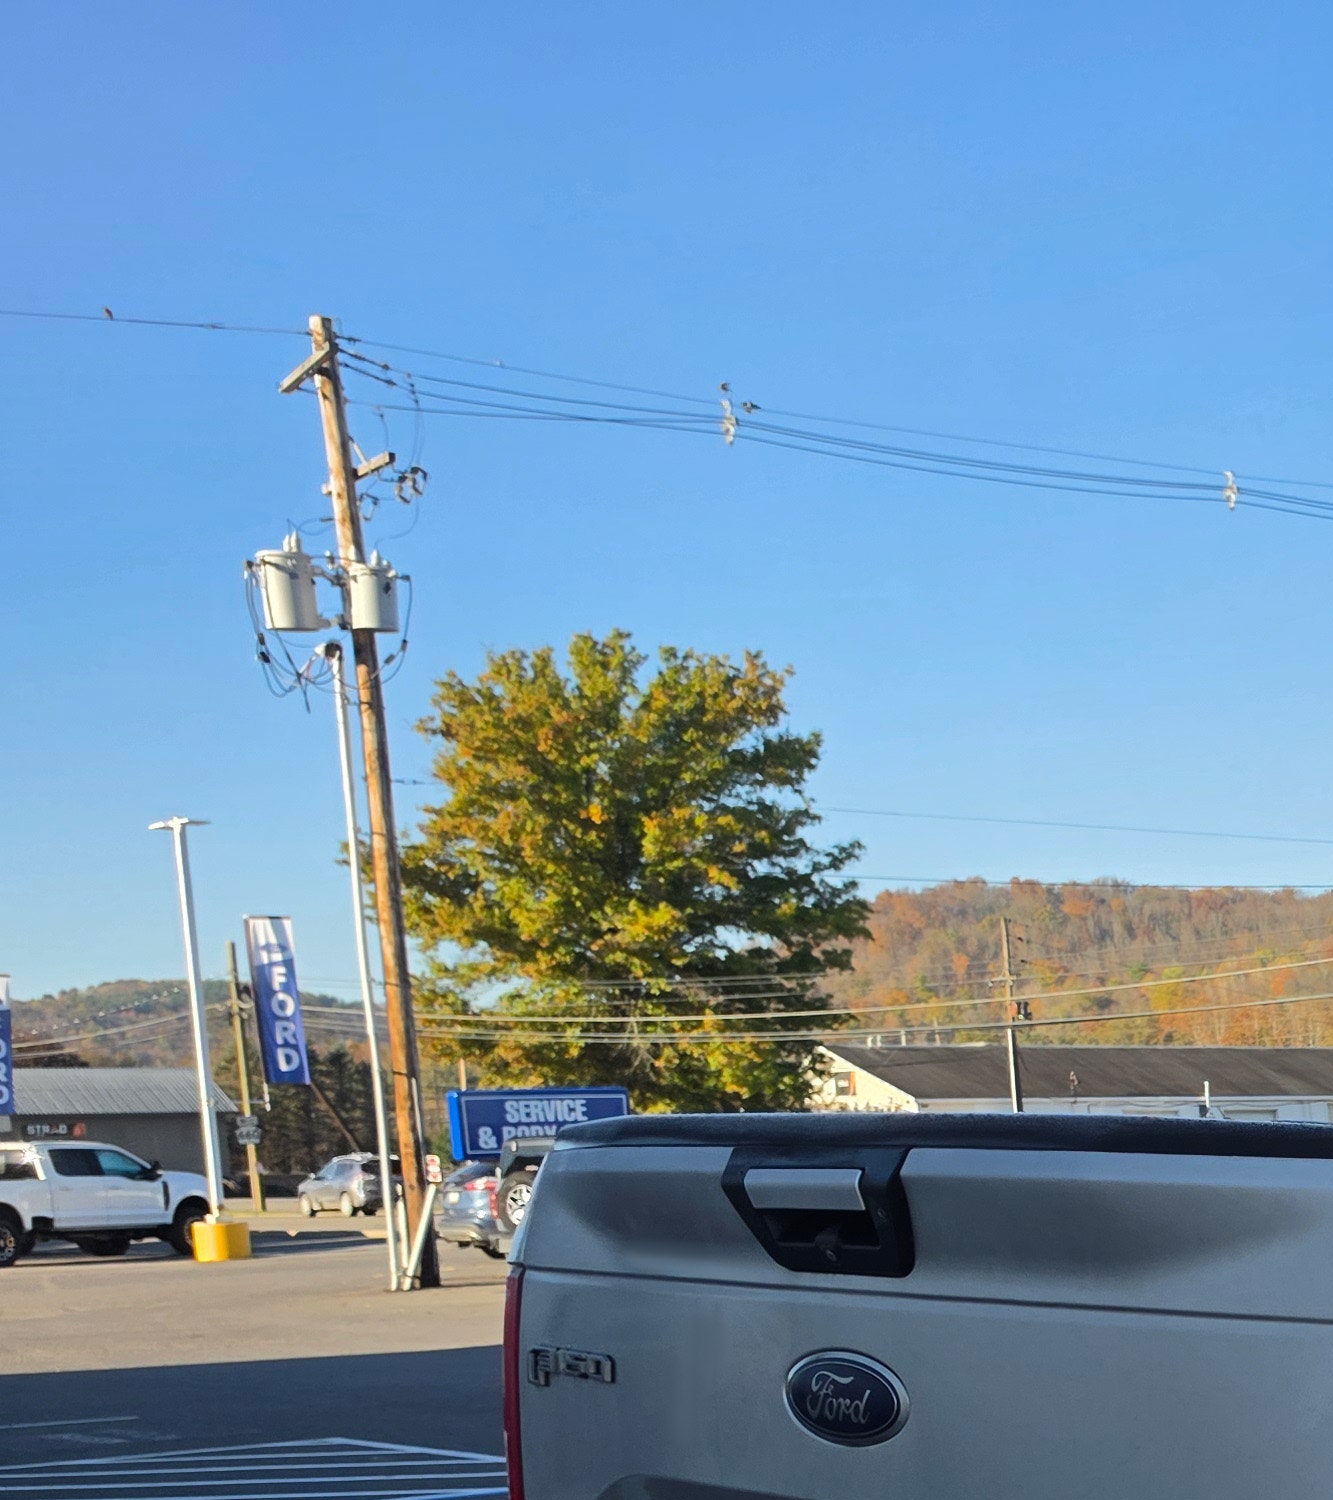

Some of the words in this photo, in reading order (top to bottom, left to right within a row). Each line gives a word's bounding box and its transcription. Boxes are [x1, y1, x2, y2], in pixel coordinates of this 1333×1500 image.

[270, 965, 300, 1072] FORD
[505, 1099, 588, 1123] SERVICE
[478, 1126, 497, 1149] &
[806, 1370, 871, 1425] Ford
